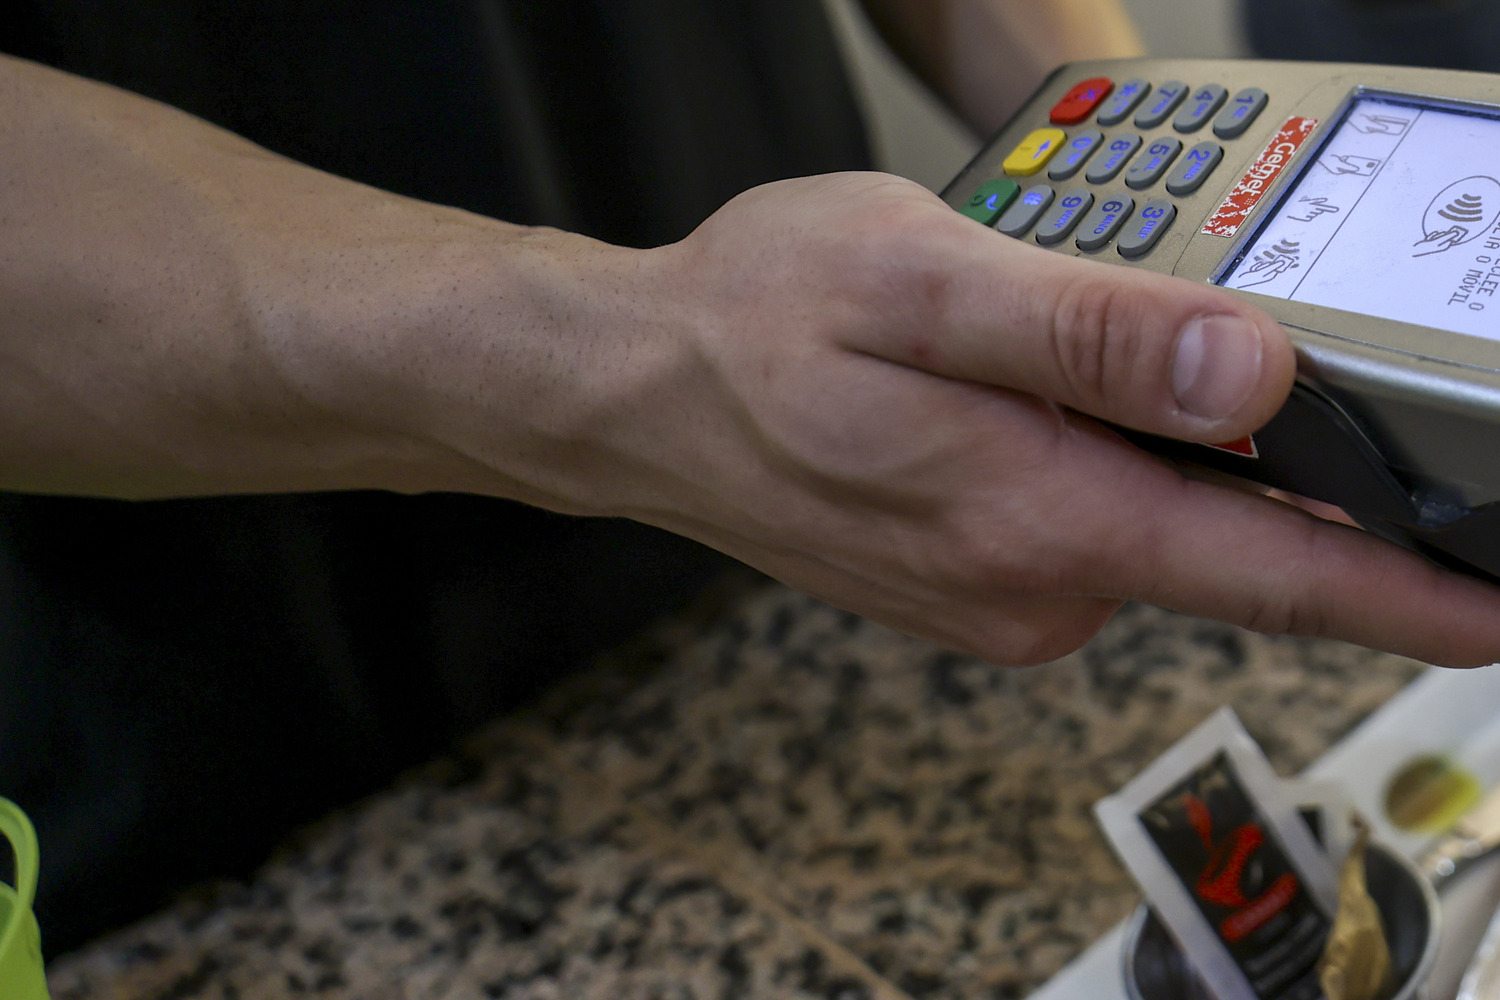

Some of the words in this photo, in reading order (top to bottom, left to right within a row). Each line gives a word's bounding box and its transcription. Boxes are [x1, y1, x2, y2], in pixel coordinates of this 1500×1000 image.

[1159, 88, 1179, 98] 7
[1195, 90, 1213, 101] 4
[1071, 137, 1093, 149] 0
[1110, 140, 1131, 151] 8
[1149, 143, 1170, 155] 5
[1187, 149, 1211, 161] 2
[1240, 142, 1295, 197] Getnet
[1061, 196, 1082, 209] 9
[1102, 201, 1123, 213] 6
[1142, 206, 1164, 219] 3
[1053, 209, 1075, 229] WXY
[1093, 214, 1117, 235] MNO
[1137, 220, 1157, 239] DEF
[1475, 255, 1492, 265] O
[1447, 268, 1485, 307] MÓVIL
[1468, 301, 1485, 312] O
